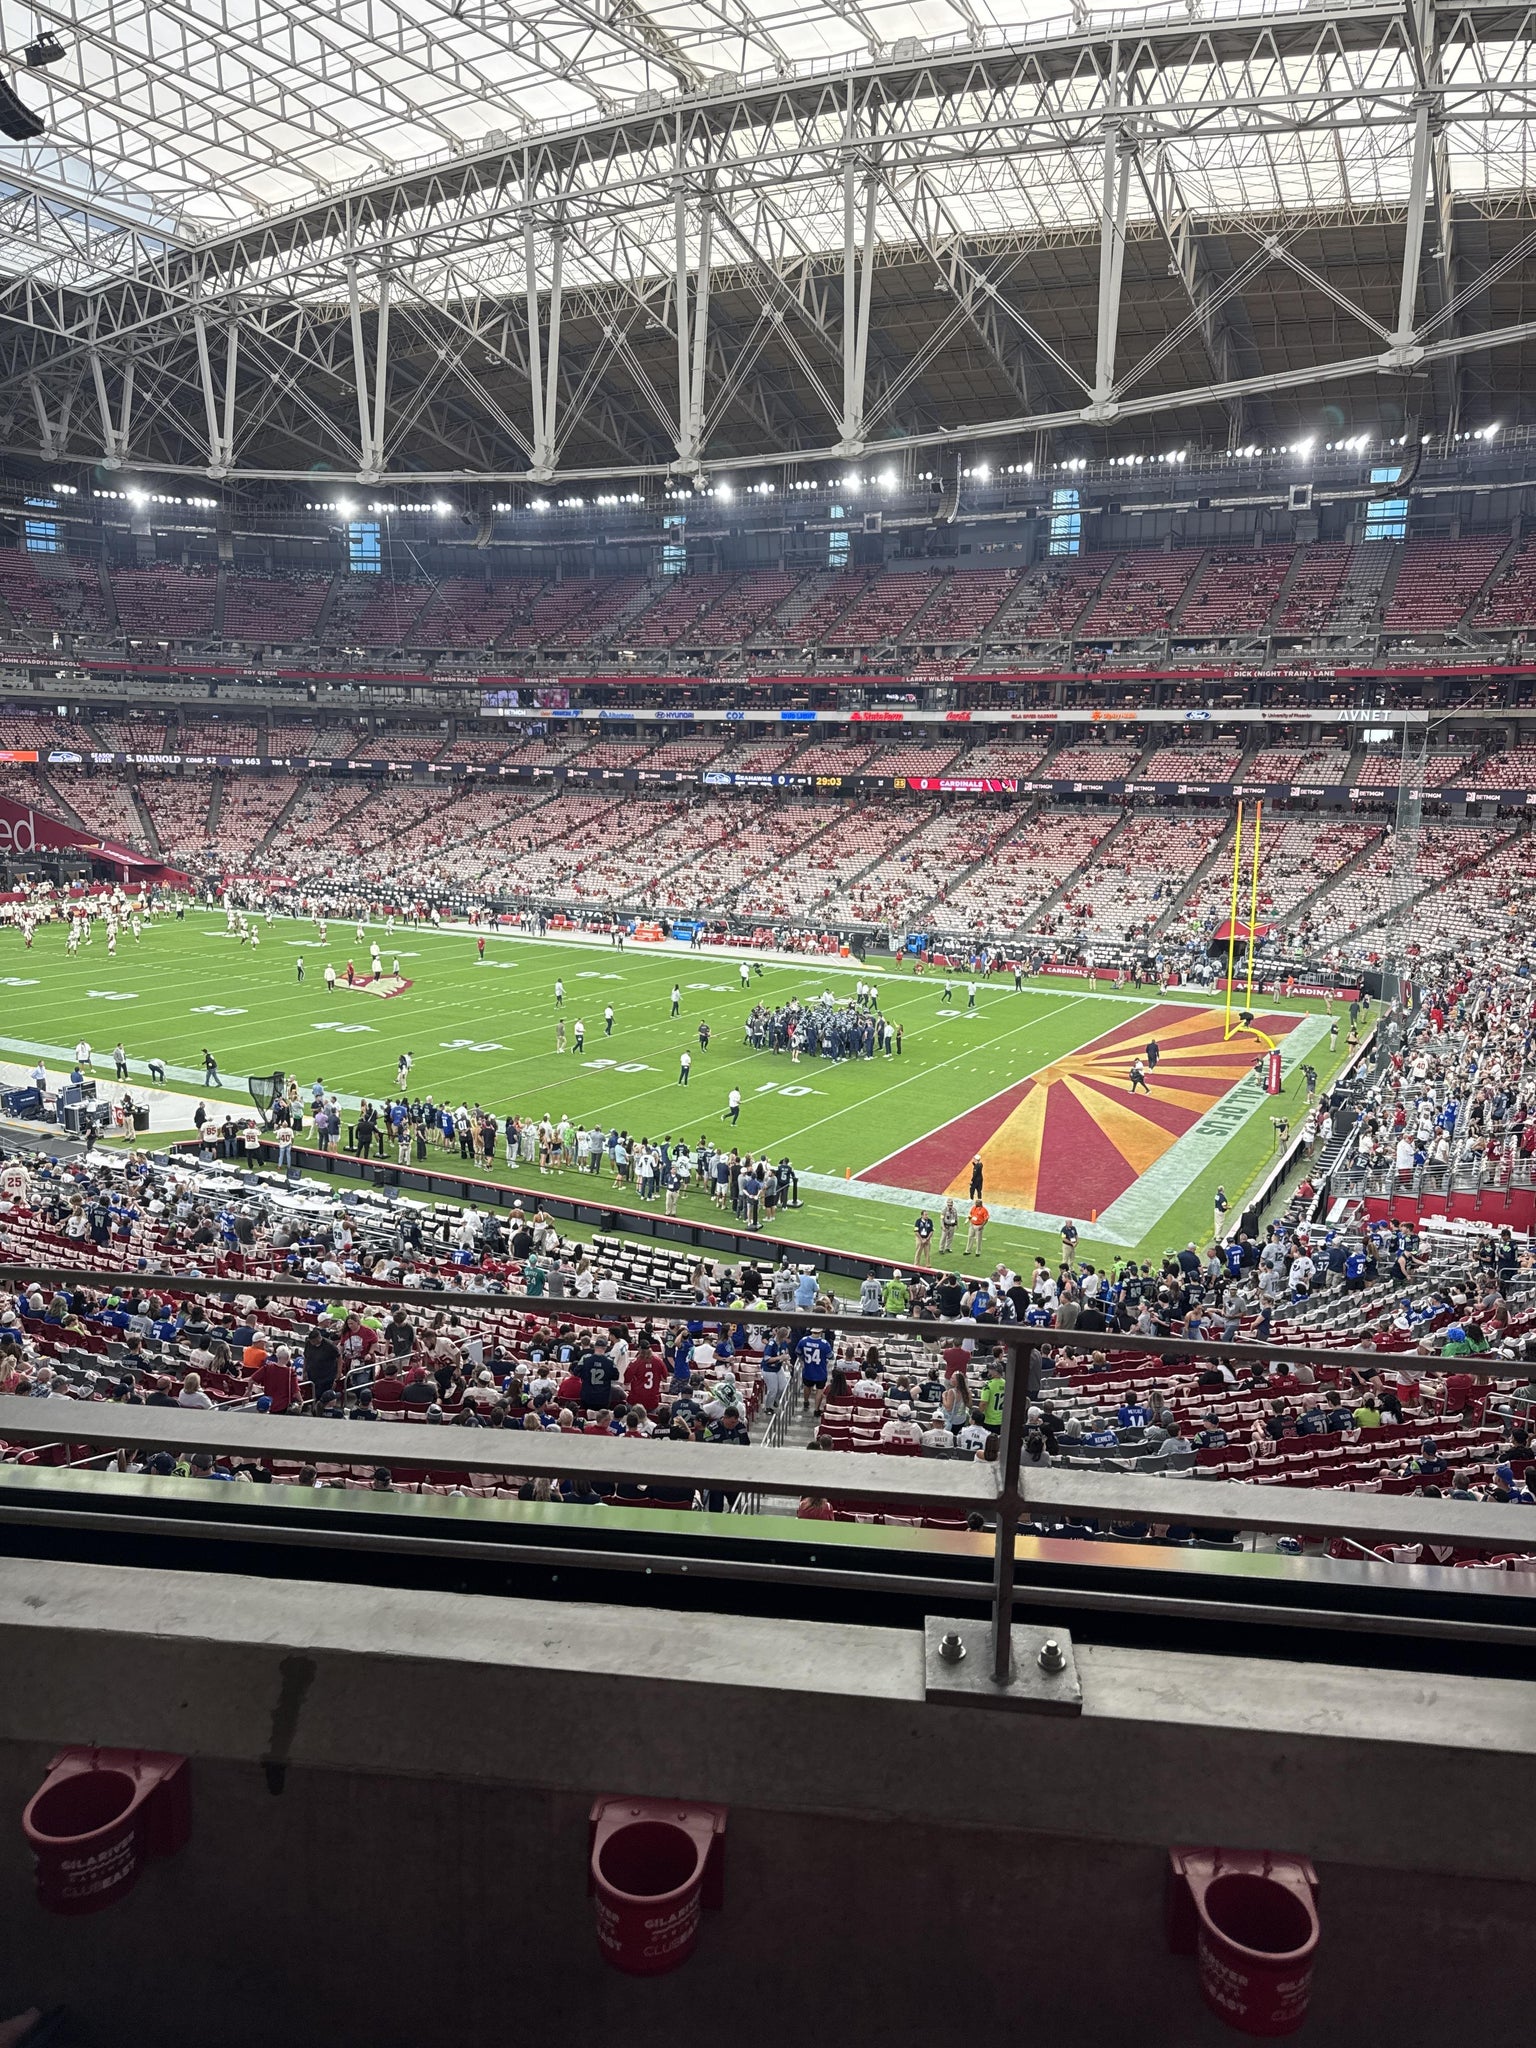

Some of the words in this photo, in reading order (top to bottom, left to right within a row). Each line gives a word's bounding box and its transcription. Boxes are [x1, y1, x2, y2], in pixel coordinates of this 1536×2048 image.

[1337, 710, 1392, 721] AVNET
[136, 755, 181, 763] DARNOLD
[816, 777, 842, 785] 29:03
[921, 780, 928, 789] 0
[190, 1005, 249, 1016] 50
[310, 1022, 371, 1033] 40
[439, 1040, 503, 1052] 30
[580, 1059, 649, 1072] 20
[755, 1082, 814, 1096] 10
[1212, 1106, 1248, 1120] OF
[458, 1120, 467, 1130] 01
[1195, 1120, 1236, 1136] US
[280, 1134, 291, 1143] 40
[1356, 1158, 1368, 1168] 12
[8, 1178, 22, 1187] 25
[94, 1215, 104, 1227] 14
[454, 1256, 461, 1264] 11
[1233, 1254, 1240, 1265] 11
[1275, 1252, 1284, 1261] 12
[1317, 1261, 1329, 1271] 37
[1357, 1264, 1363, 1274] 9
[526, 1276, 536, 1285] 24
[782, 1291, 793, 1302] 11
[868, 1289, 876, 1300] 11
[892, 1290, 899, 1299] 14
[1009, 1304, 1016, 1319] 3
[754, 1326, 764, 1335] 36
[804, 1347, 821, 1365] 54
[590, 1368, 605, 1385] 12
[644, 1371, 654, 1389] 3
[928, 1390, 941, 1401] 54
[1130, 1416, 1144, 1427] 14
[1314, 1420, 1328, 1434] 31
[966, 1440, 983, 1450] 12
[645, 1913, 677, 1929] GILA
